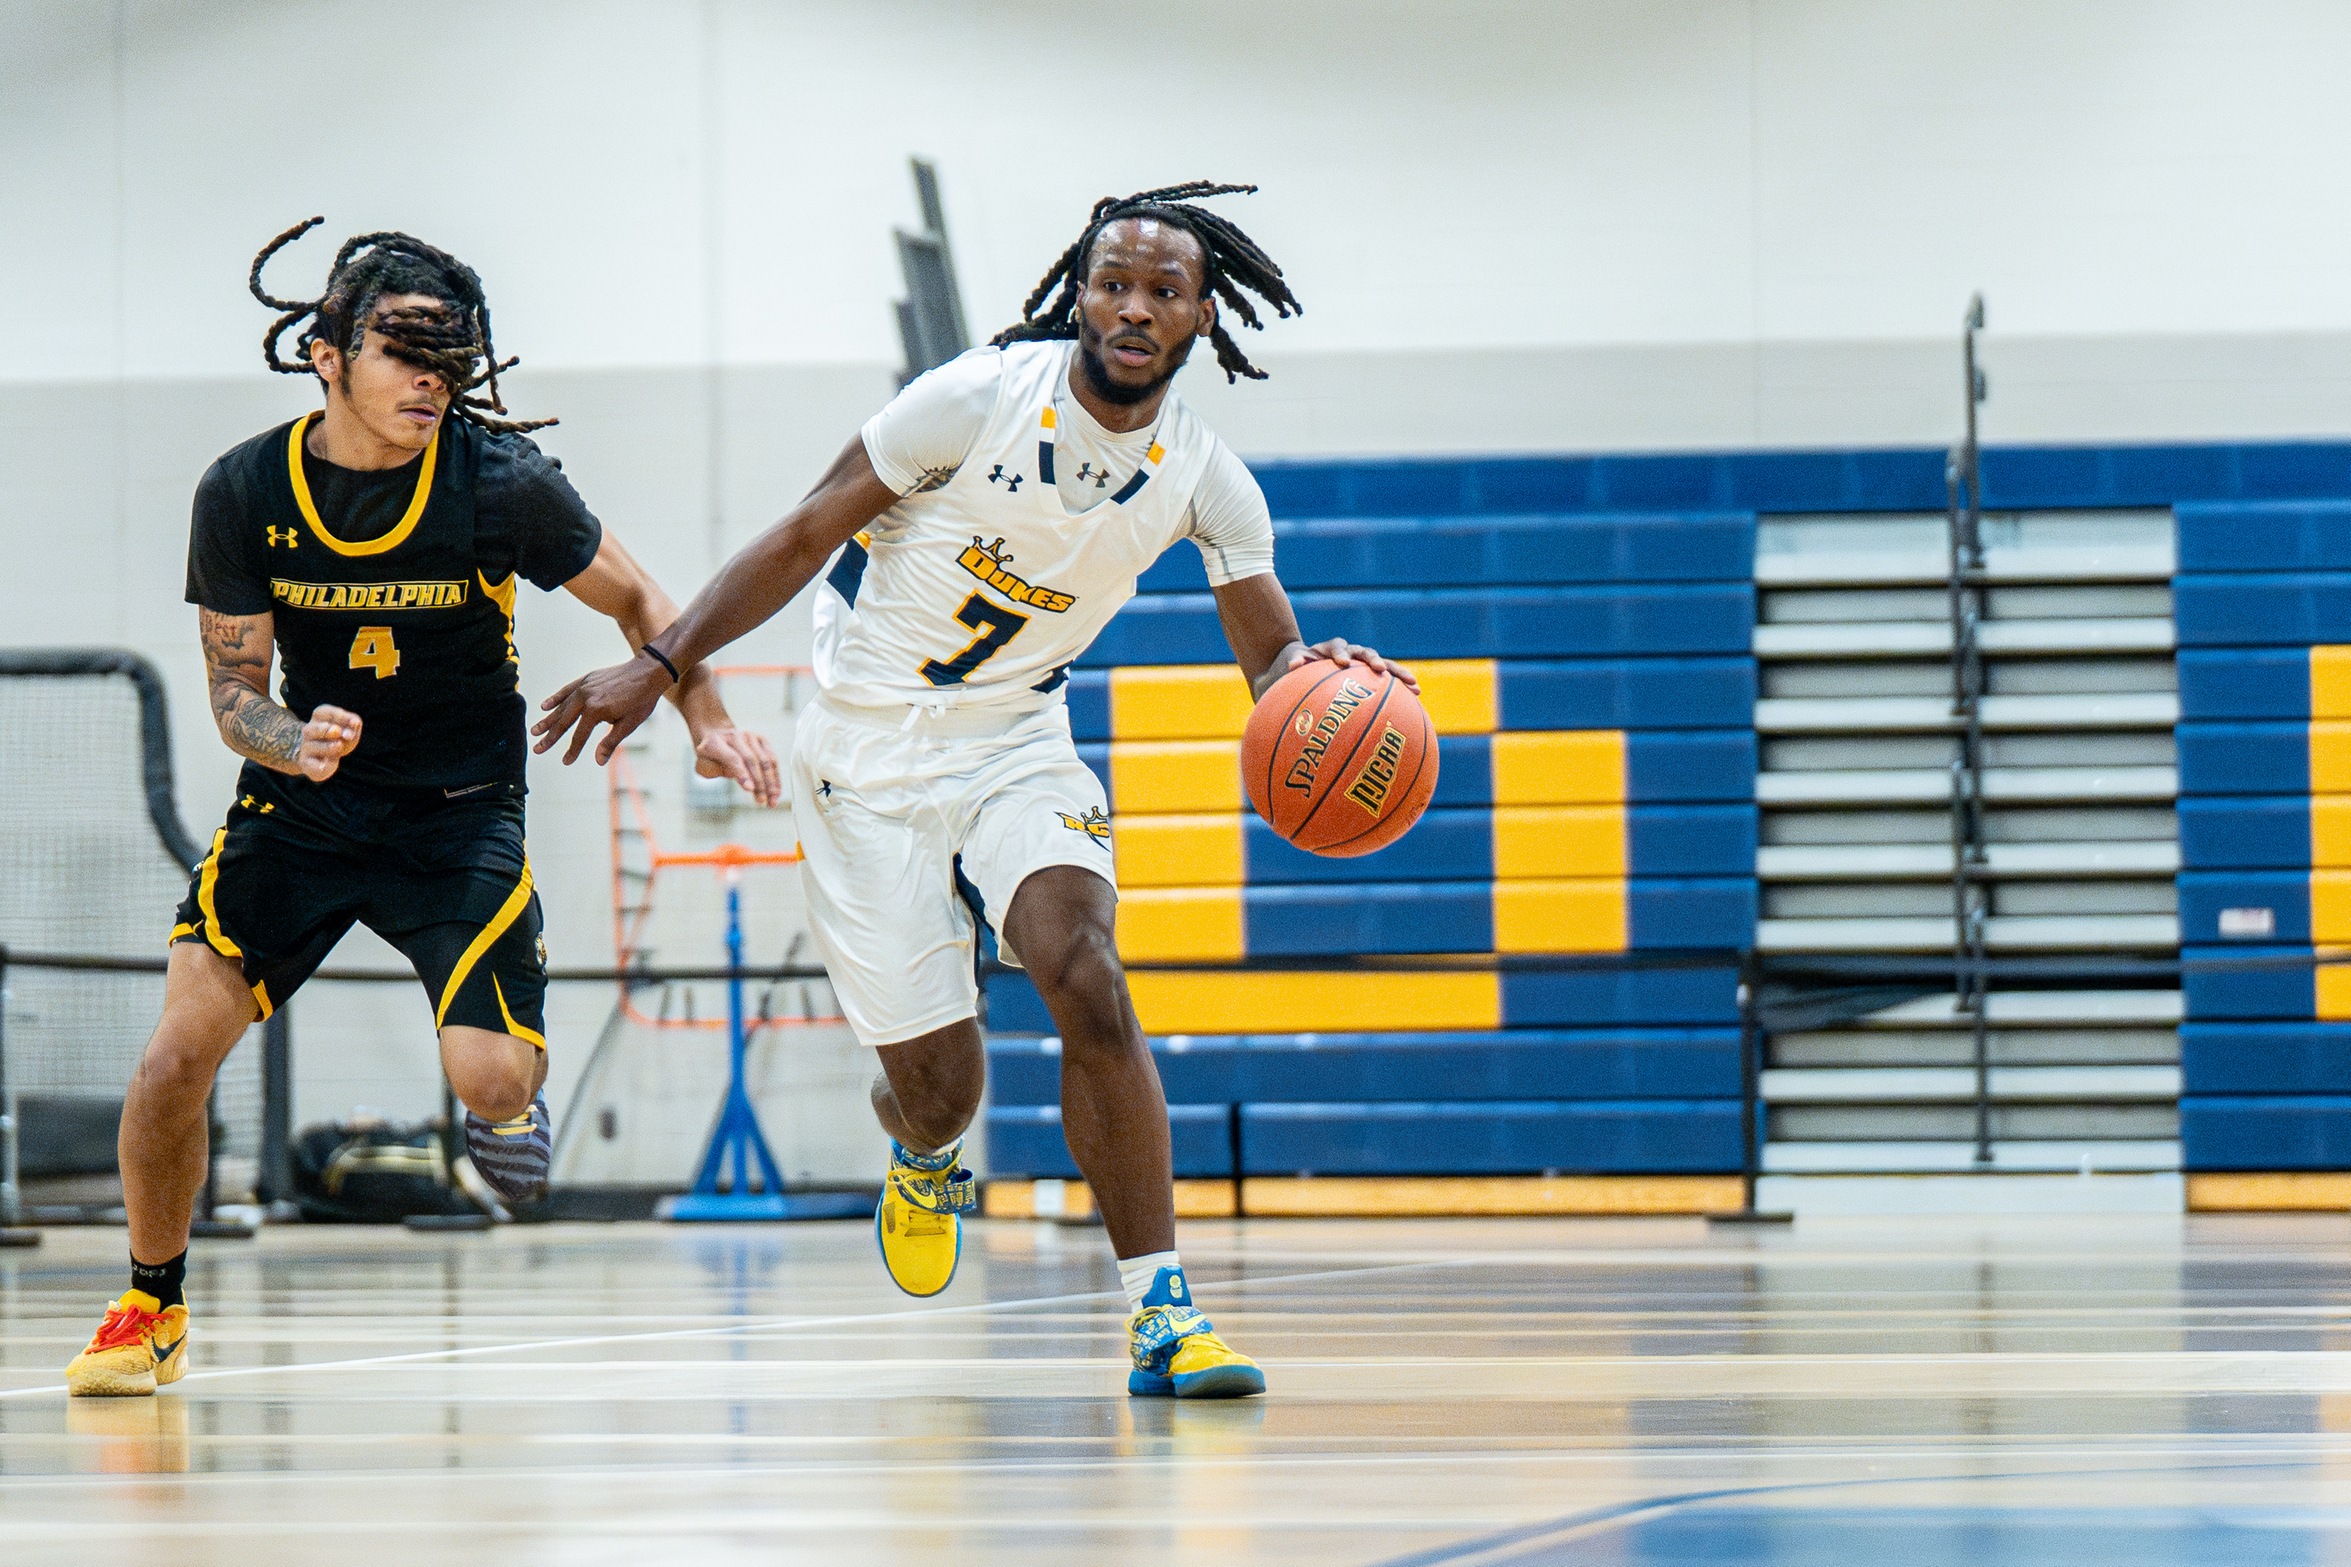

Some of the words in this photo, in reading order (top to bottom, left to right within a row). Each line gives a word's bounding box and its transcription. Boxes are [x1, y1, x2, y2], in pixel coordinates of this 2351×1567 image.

[272, 581, 463, 607] PHILADELPHIA
[956, 547, 1076, 613] DUKES
[349, 626, 400, 680] 4
[916, 587, 1032, 687] 7
[1284, 677, 1376, 798] SPALDING
[1344, 727, 1407, 818] NJCAA
